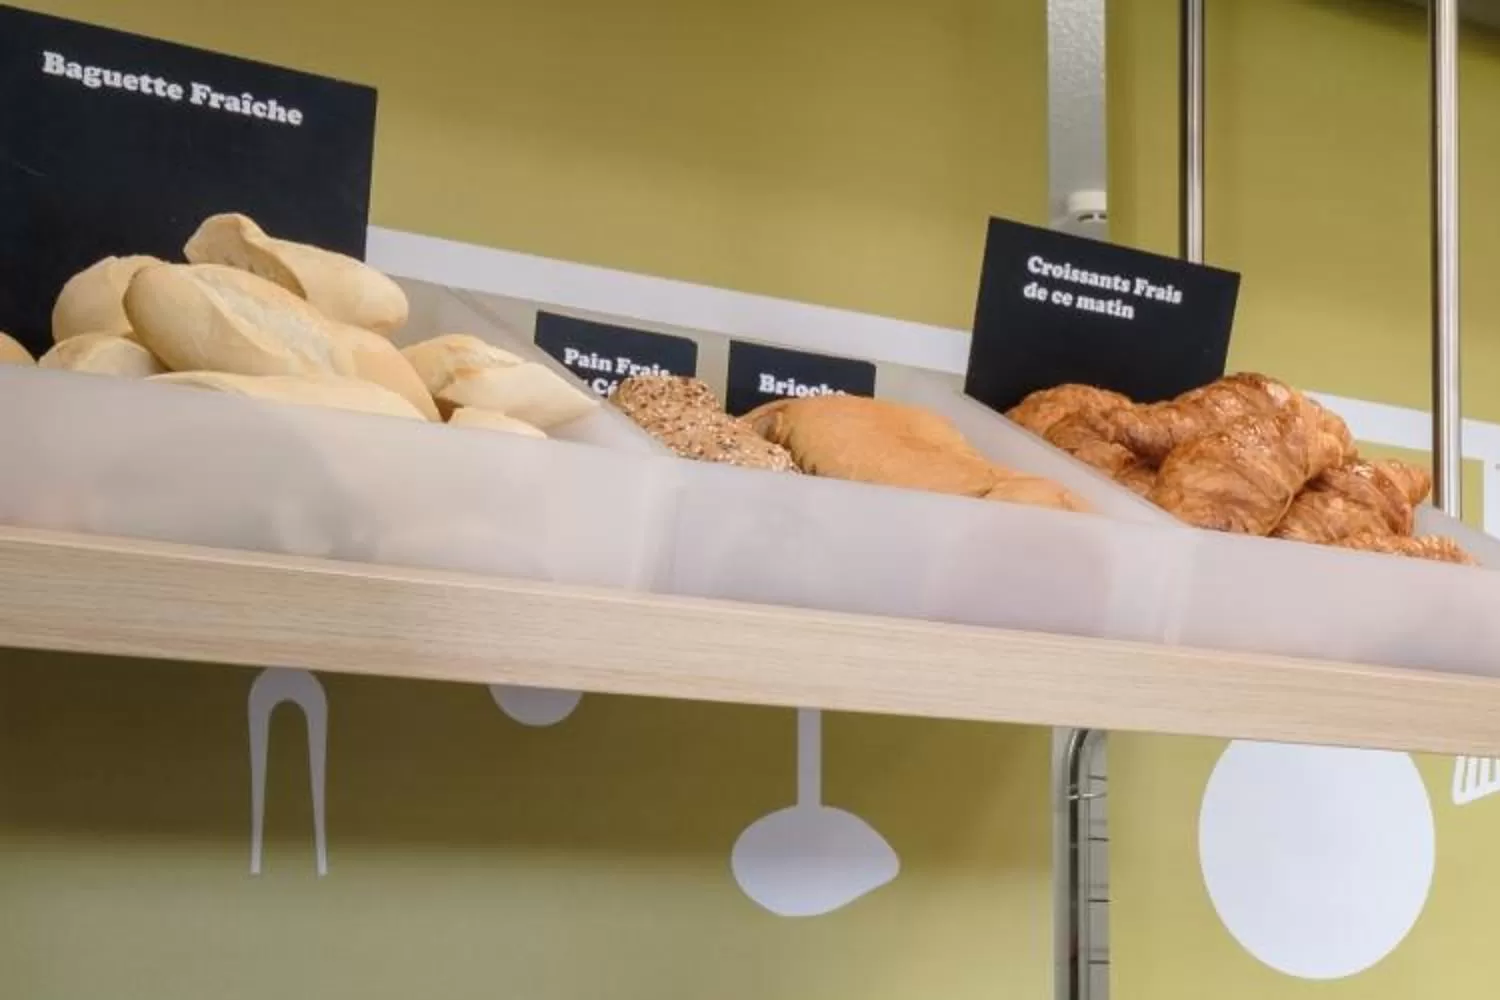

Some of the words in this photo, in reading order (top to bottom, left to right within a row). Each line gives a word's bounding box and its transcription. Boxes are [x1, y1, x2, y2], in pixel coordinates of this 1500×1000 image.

[42, 51, 184, 101] Baguette
[190, 81, 303, 126] Fraîche
[1023, 282, 1048, 302] de
[1051, 289, 1074, 307] ce
[1076, 294, 1135, 320] matin
[1027, 255, 1131, 293] Croissants
[1133, 277, 1183, 305] Frais
[564, 347, 612, 373] Pain
